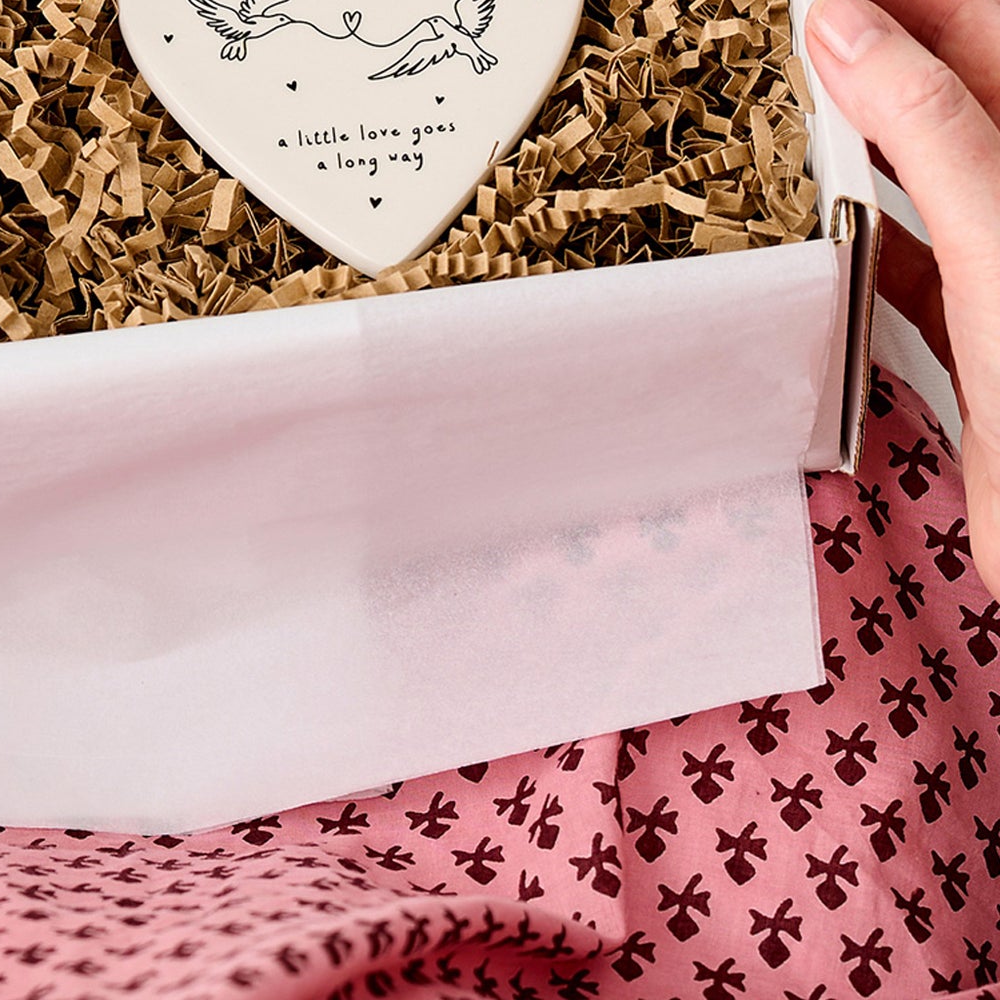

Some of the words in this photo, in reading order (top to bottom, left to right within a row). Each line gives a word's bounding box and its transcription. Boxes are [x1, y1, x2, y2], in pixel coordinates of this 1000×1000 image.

[278, 138, 288, 148] a
[298, 126, 350, 147] little
[359, 124, 401, 141] love
[411, 122, 456, 146] goes
[317, 160, 328, 170] a
[337, 152, 378, 176] long
[388, 151, 424, 171] way
